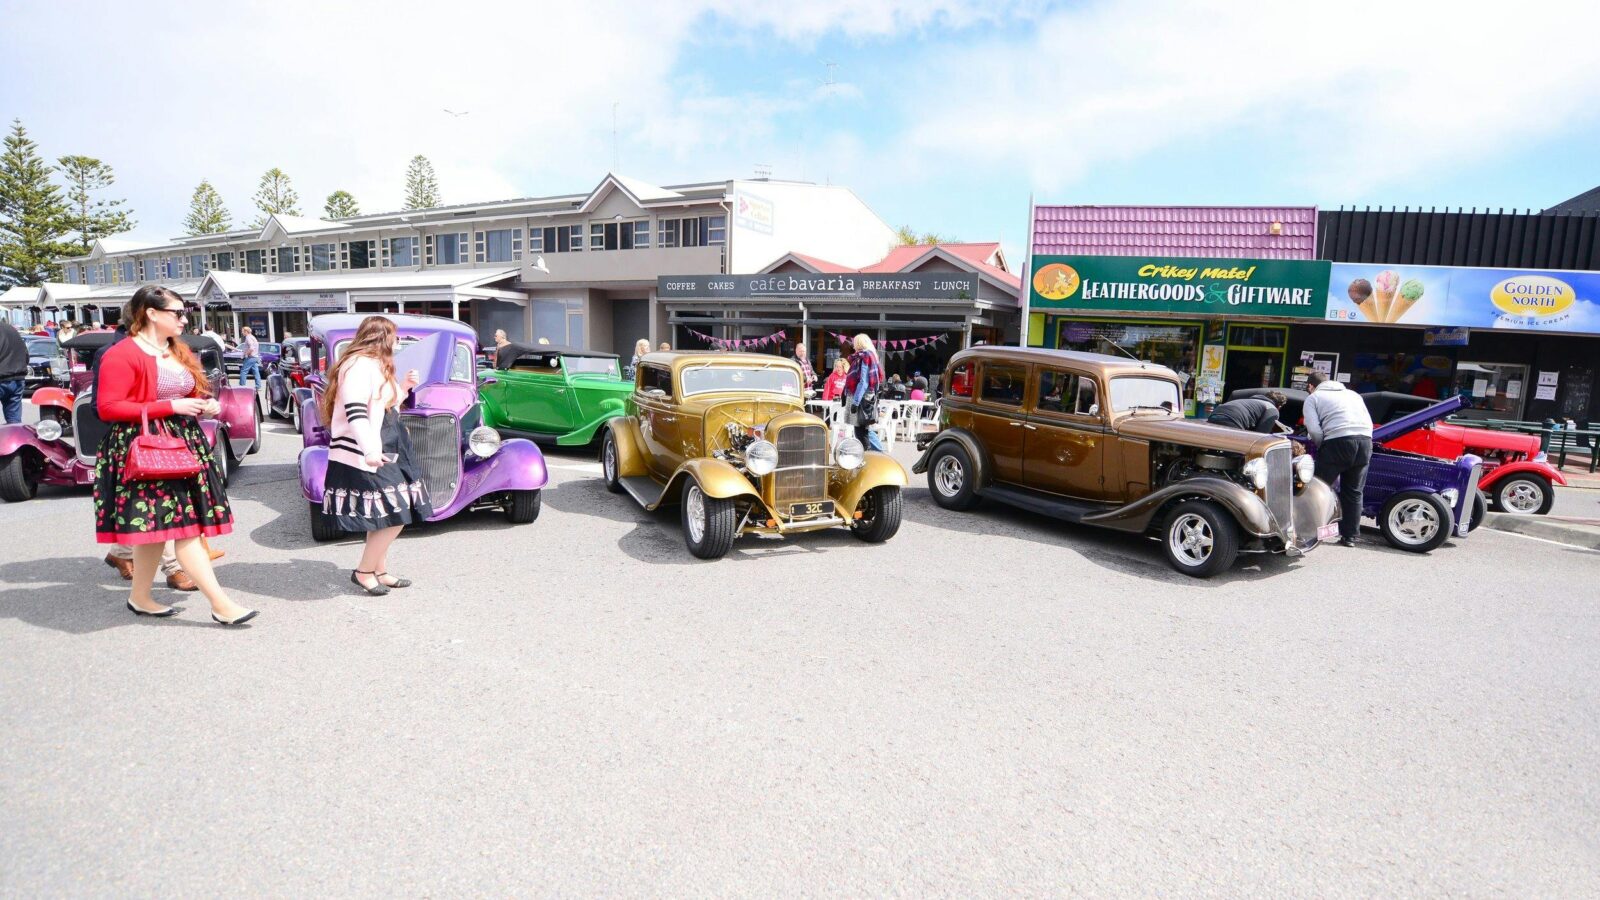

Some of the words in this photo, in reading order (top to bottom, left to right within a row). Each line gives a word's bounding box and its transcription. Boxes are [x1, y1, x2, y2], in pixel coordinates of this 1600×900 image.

[1137, 264, 1198, 280] Crikey
[1200, 266, 1257, 281] Mate!
[666, 282, 696, 291] COFFEE
[707, 281, 735, 290] CAKES
[862, 280, 922, 290] BREAKFAST
[933, 280, 970, 291] LUNCH
[1503, 281, 1564, 296] GOLDEN
[1081, 278, 1205, 302] LEATHERGOODS
[1203, 282, 1228, 304] &
[1227, 283, 1313, 306] GIFTWARE
[1511, 296, 1556, 307] NORTH
[1543, 314, 1570, 326] CREAM
[805, 503, 823, 514] 32C
